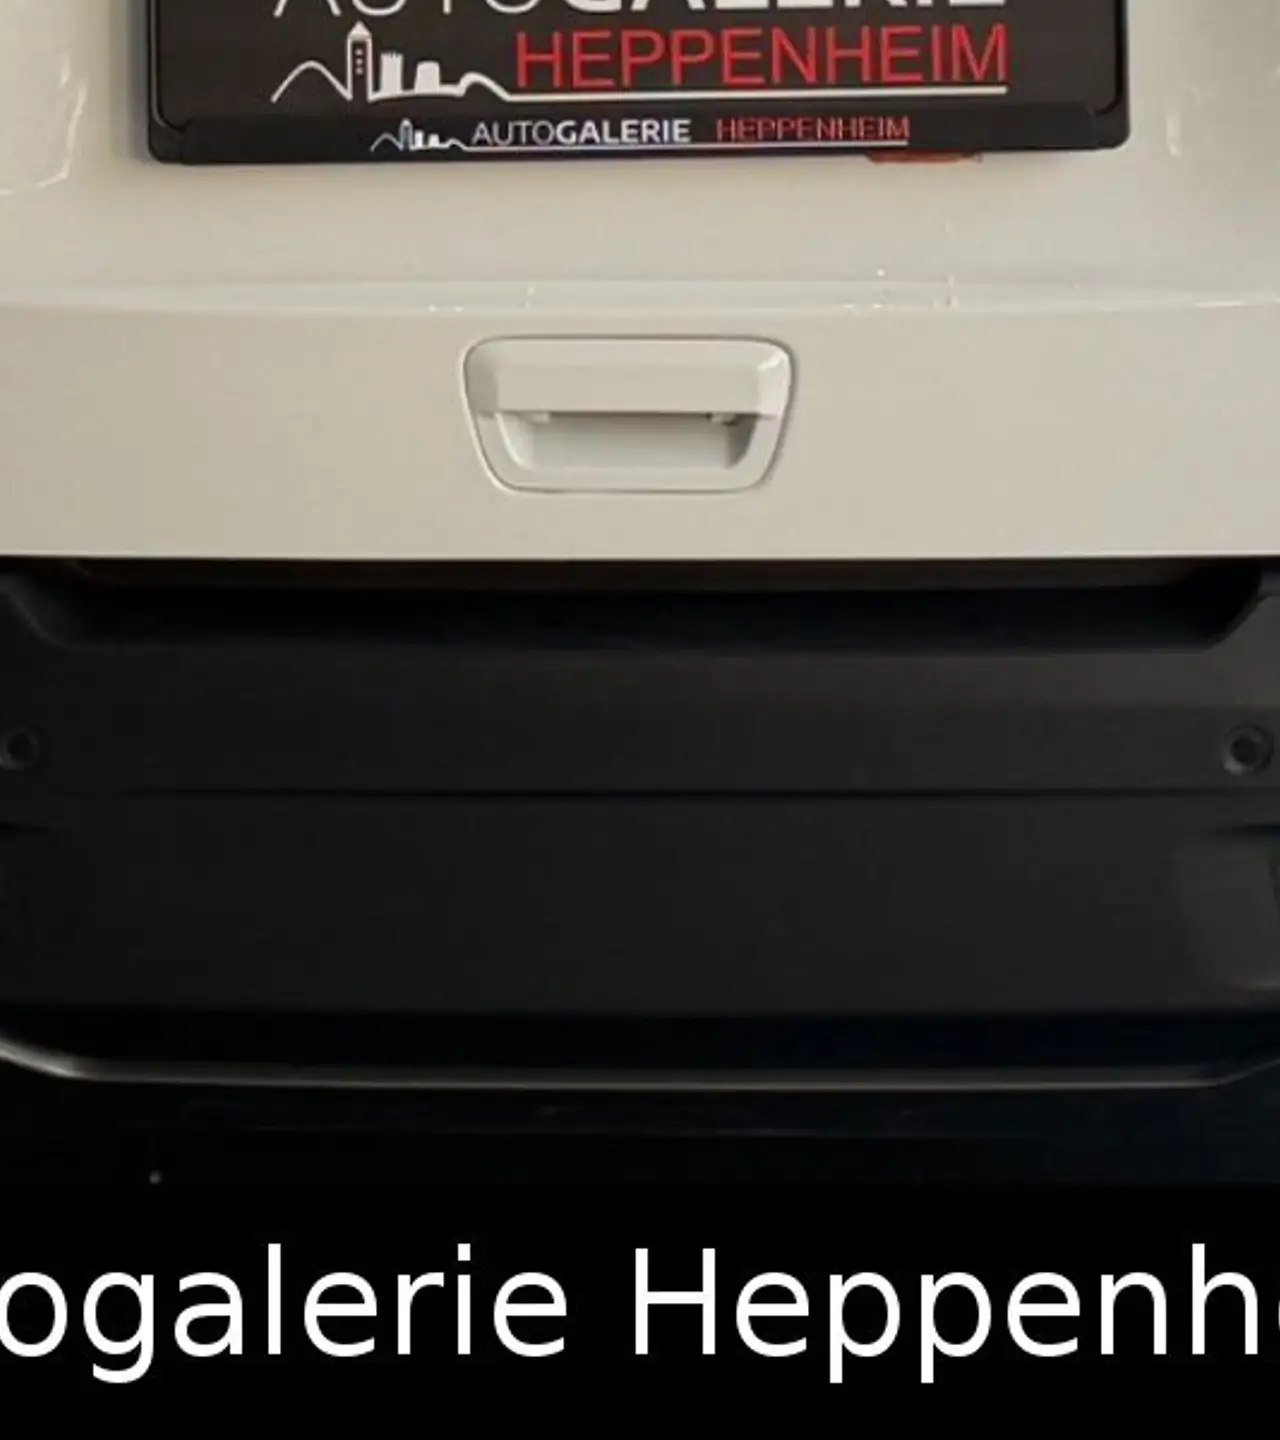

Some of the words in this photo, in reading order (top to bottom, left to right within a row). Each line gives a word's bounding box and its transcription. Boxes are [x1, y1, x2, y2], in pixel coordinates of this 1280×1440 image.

[516, 23, 1009, 88] HEPPENHEIM
[472, 119, 691, 145] AUTOGALERIE
[716, 115, 910, 141] HEPPENHEIM
